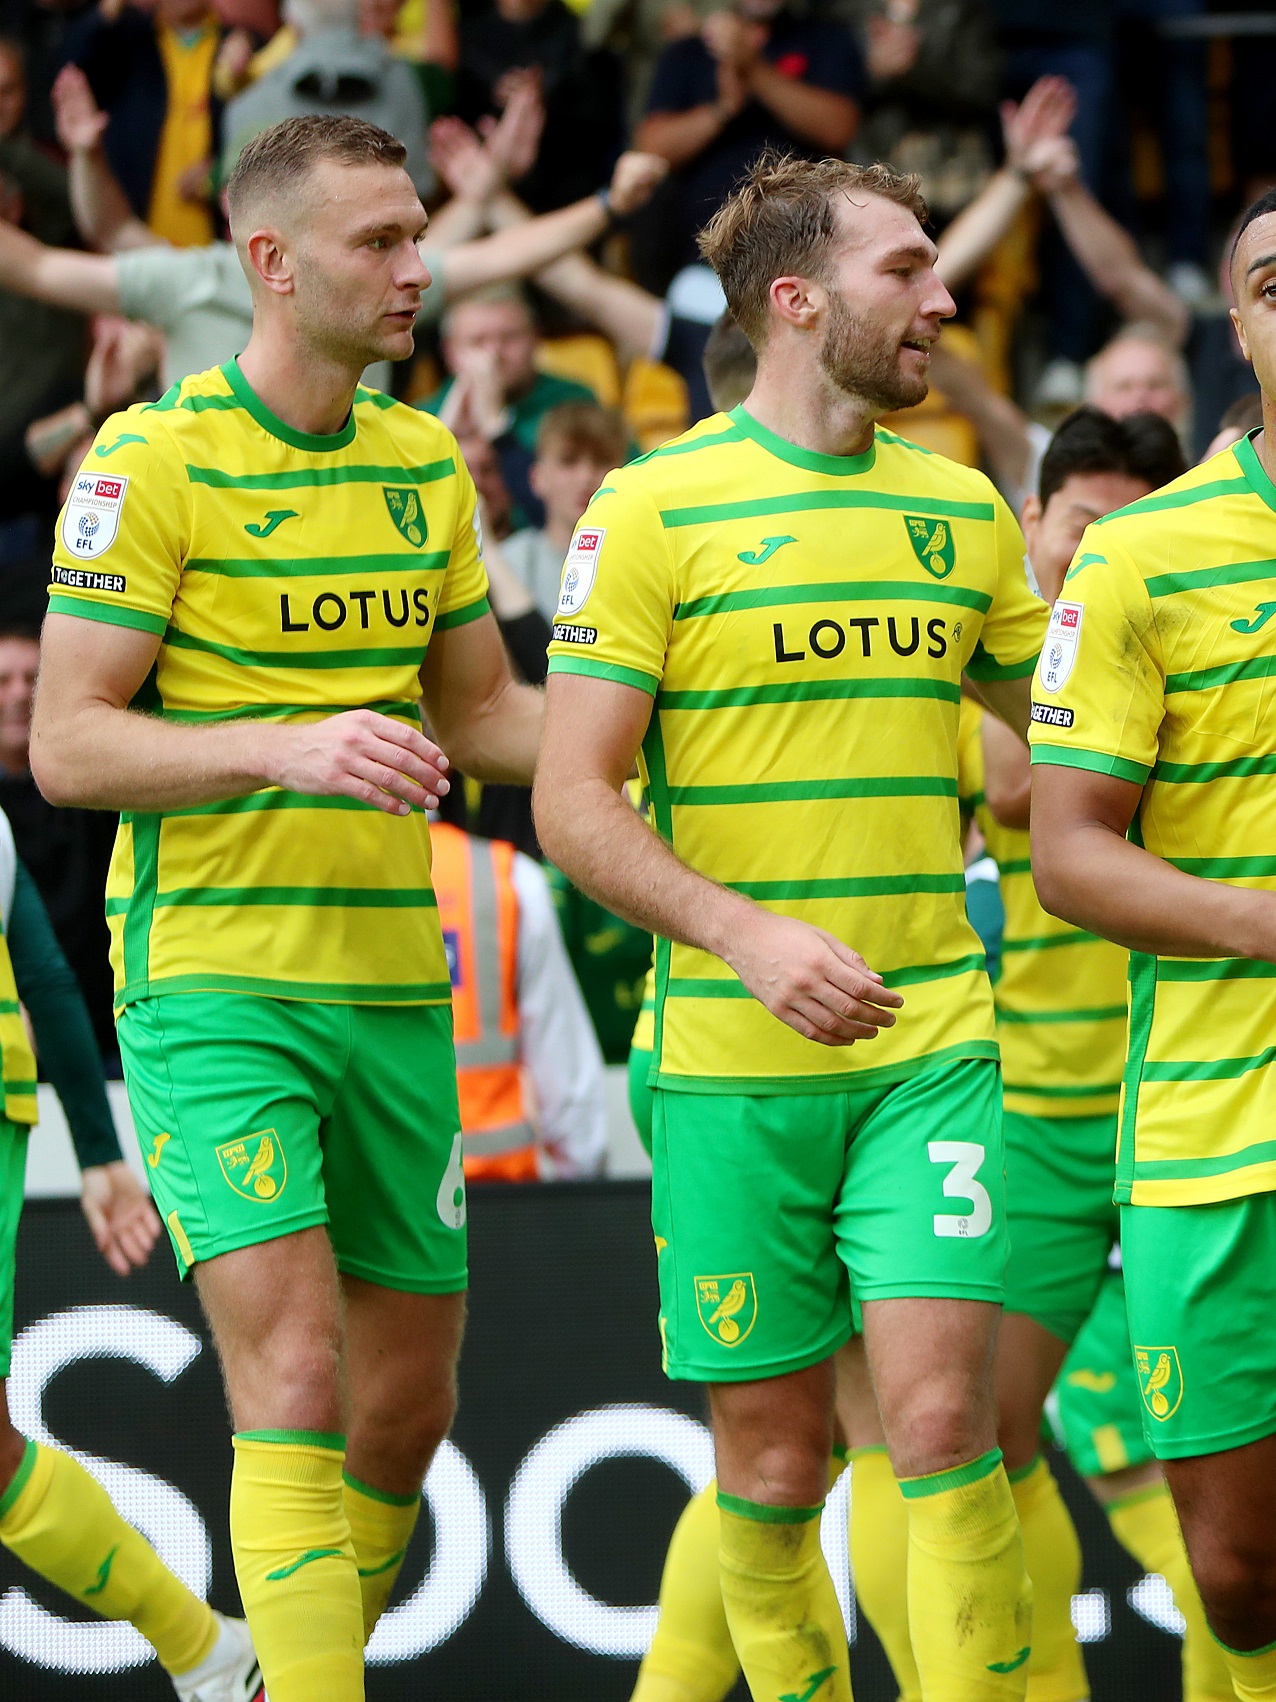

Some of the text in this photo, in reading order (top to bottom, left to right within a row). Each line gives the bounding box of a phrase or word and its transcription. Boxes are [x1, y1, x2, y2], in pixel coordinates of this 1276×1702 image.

[77, 480, 119, 495] sky bet
[72, 496, 118, 509] CHAMPIONSHIP
[76, 538, 94, 551] EFL
[579, 535, 597, 548] bet
[561, 595, 574, 605] EFL
[280, 588, 430, 633] LOTUS
[1062, 610, 1077, 625] bet
[553, 624, 596, 644] GETHER
[773, 617, 947, 663] LOTUS
[1047, 671, 1057, 683] EFL
[1031, 704, 1072, 727] GETHER
[928, 1141, 993, 1238] 3
